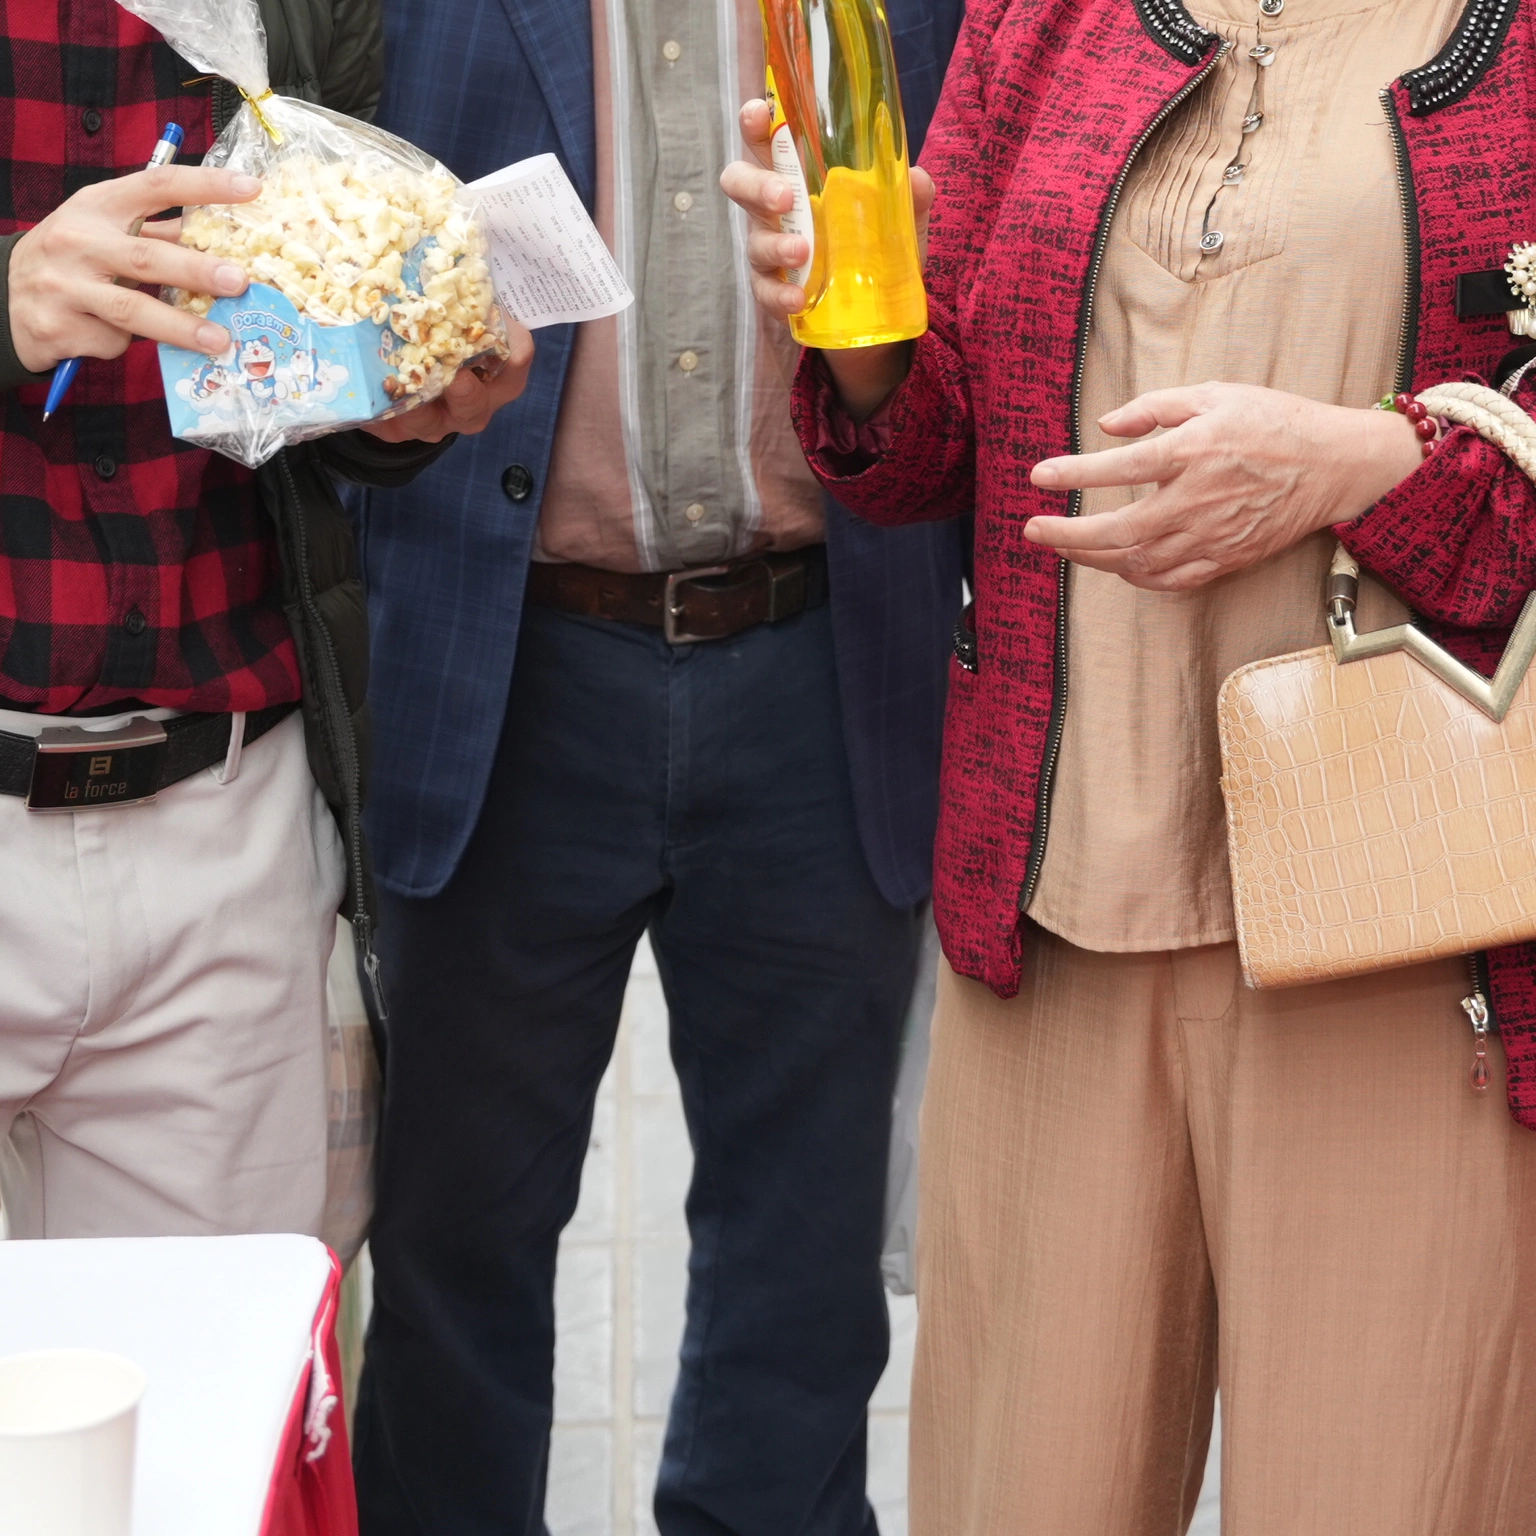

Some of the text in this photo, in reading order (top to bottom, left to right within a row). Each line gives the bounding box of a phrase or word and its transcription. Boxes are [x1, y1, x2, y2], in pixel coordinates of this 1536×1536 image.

[231, 310, 303, 346] Doraemon
[64, 779, 127, 799] la force
